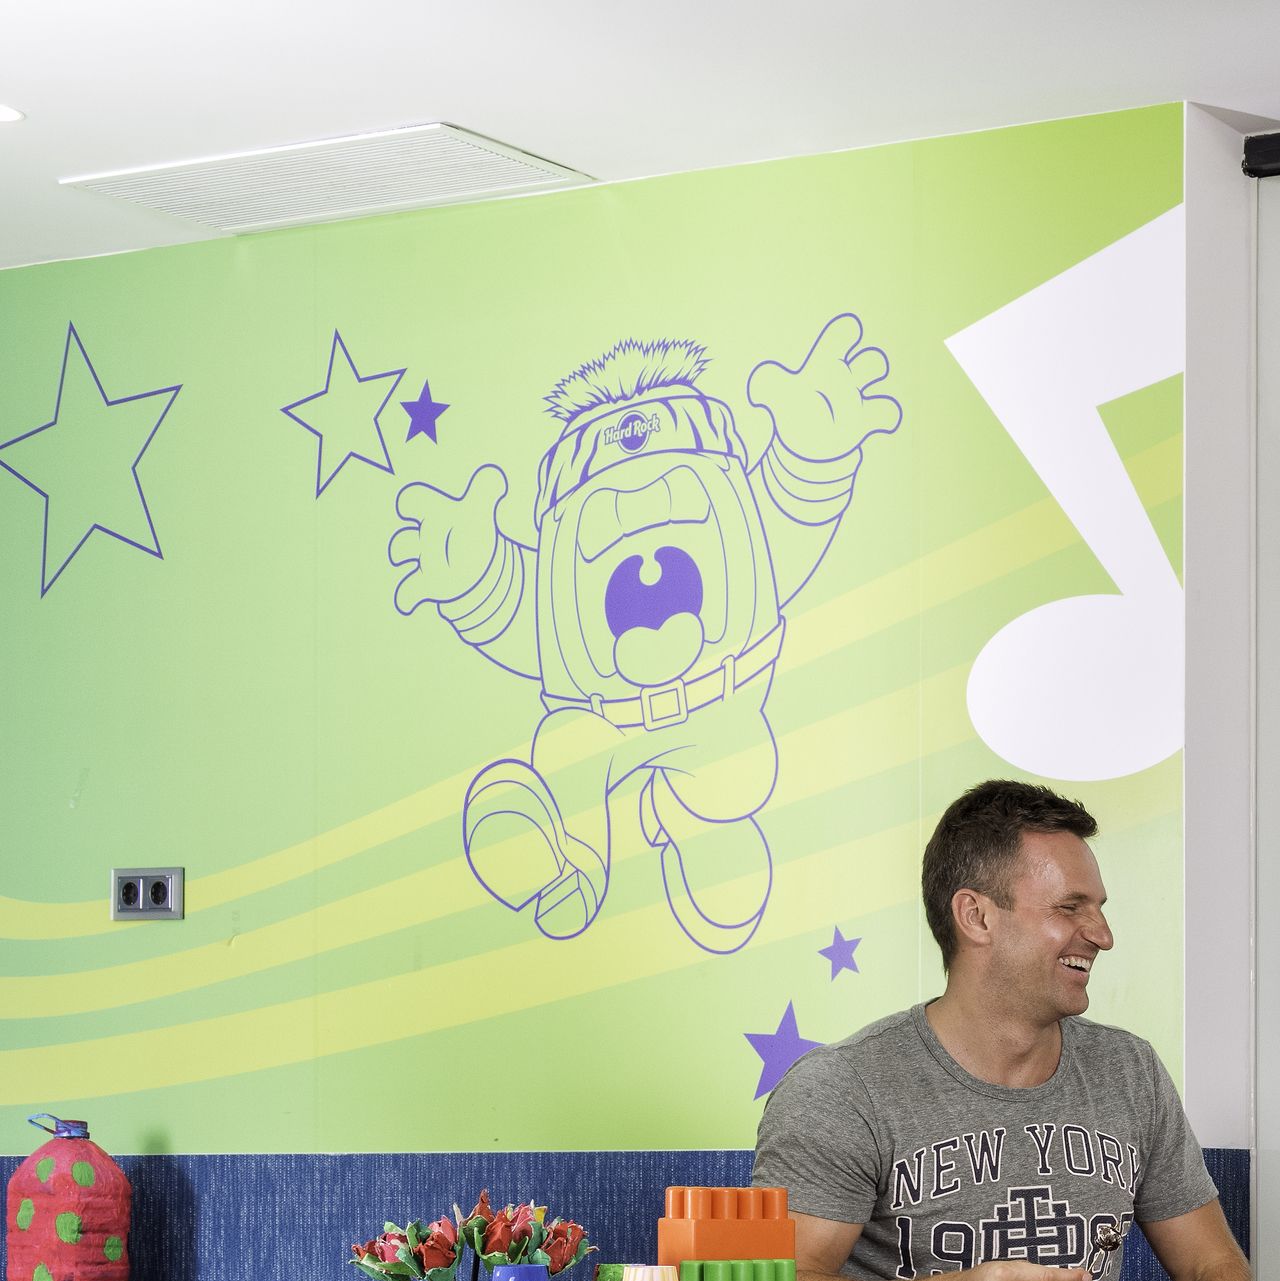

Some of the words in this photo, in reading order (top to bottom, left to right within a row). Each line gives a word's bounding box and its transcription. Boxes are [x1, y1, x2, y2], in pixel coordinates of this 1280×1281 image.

[604, 422, 632, 445] Hard
[633, 413, 661, 437] Rock
[891, 1128, 1006, 1210] NEW
